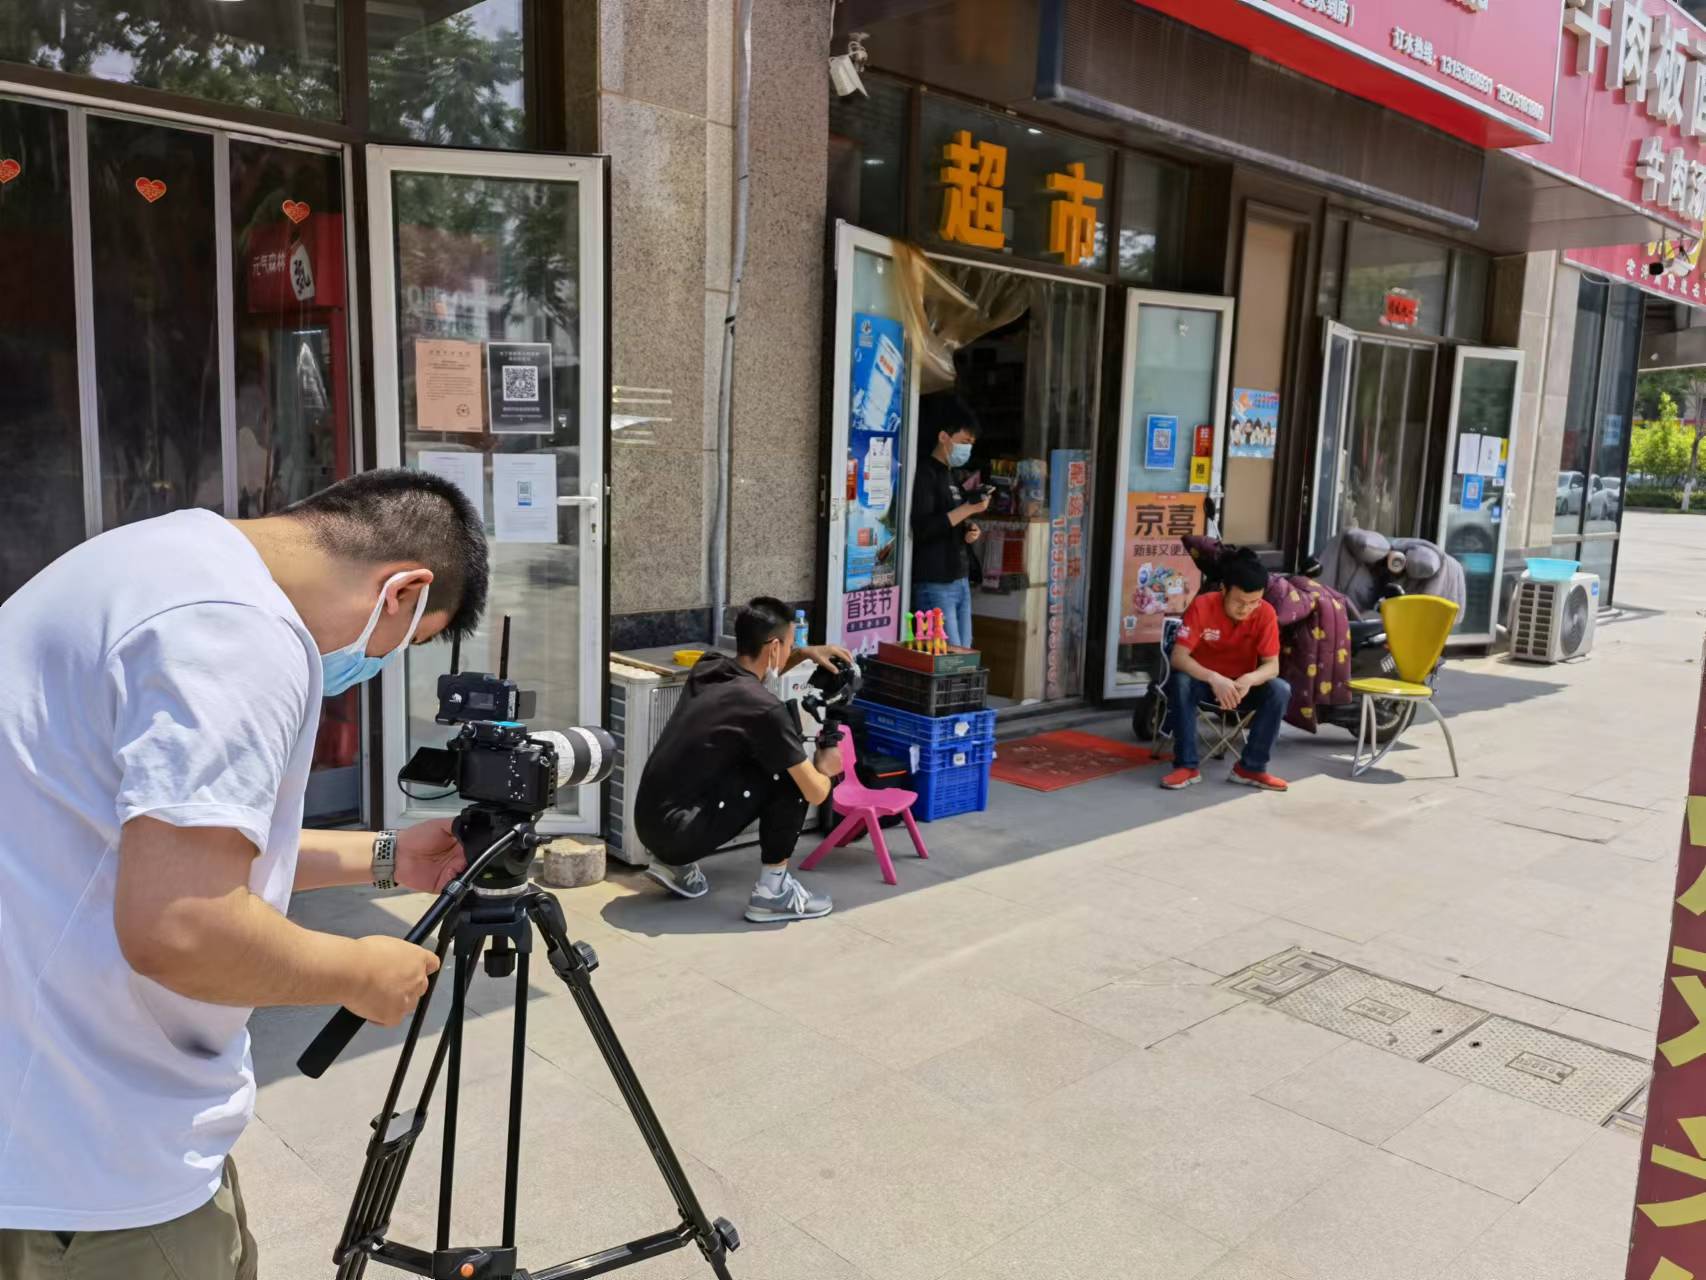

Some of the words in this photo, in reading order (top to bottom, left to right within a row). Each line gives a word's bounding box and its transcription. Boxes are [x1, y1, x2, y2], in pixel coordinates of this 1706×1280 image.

[940, 130, 1104, 266] 超市
[1134, 504, 1196, 536] 京喜
[847, 588, 892, 619] 省钱节
